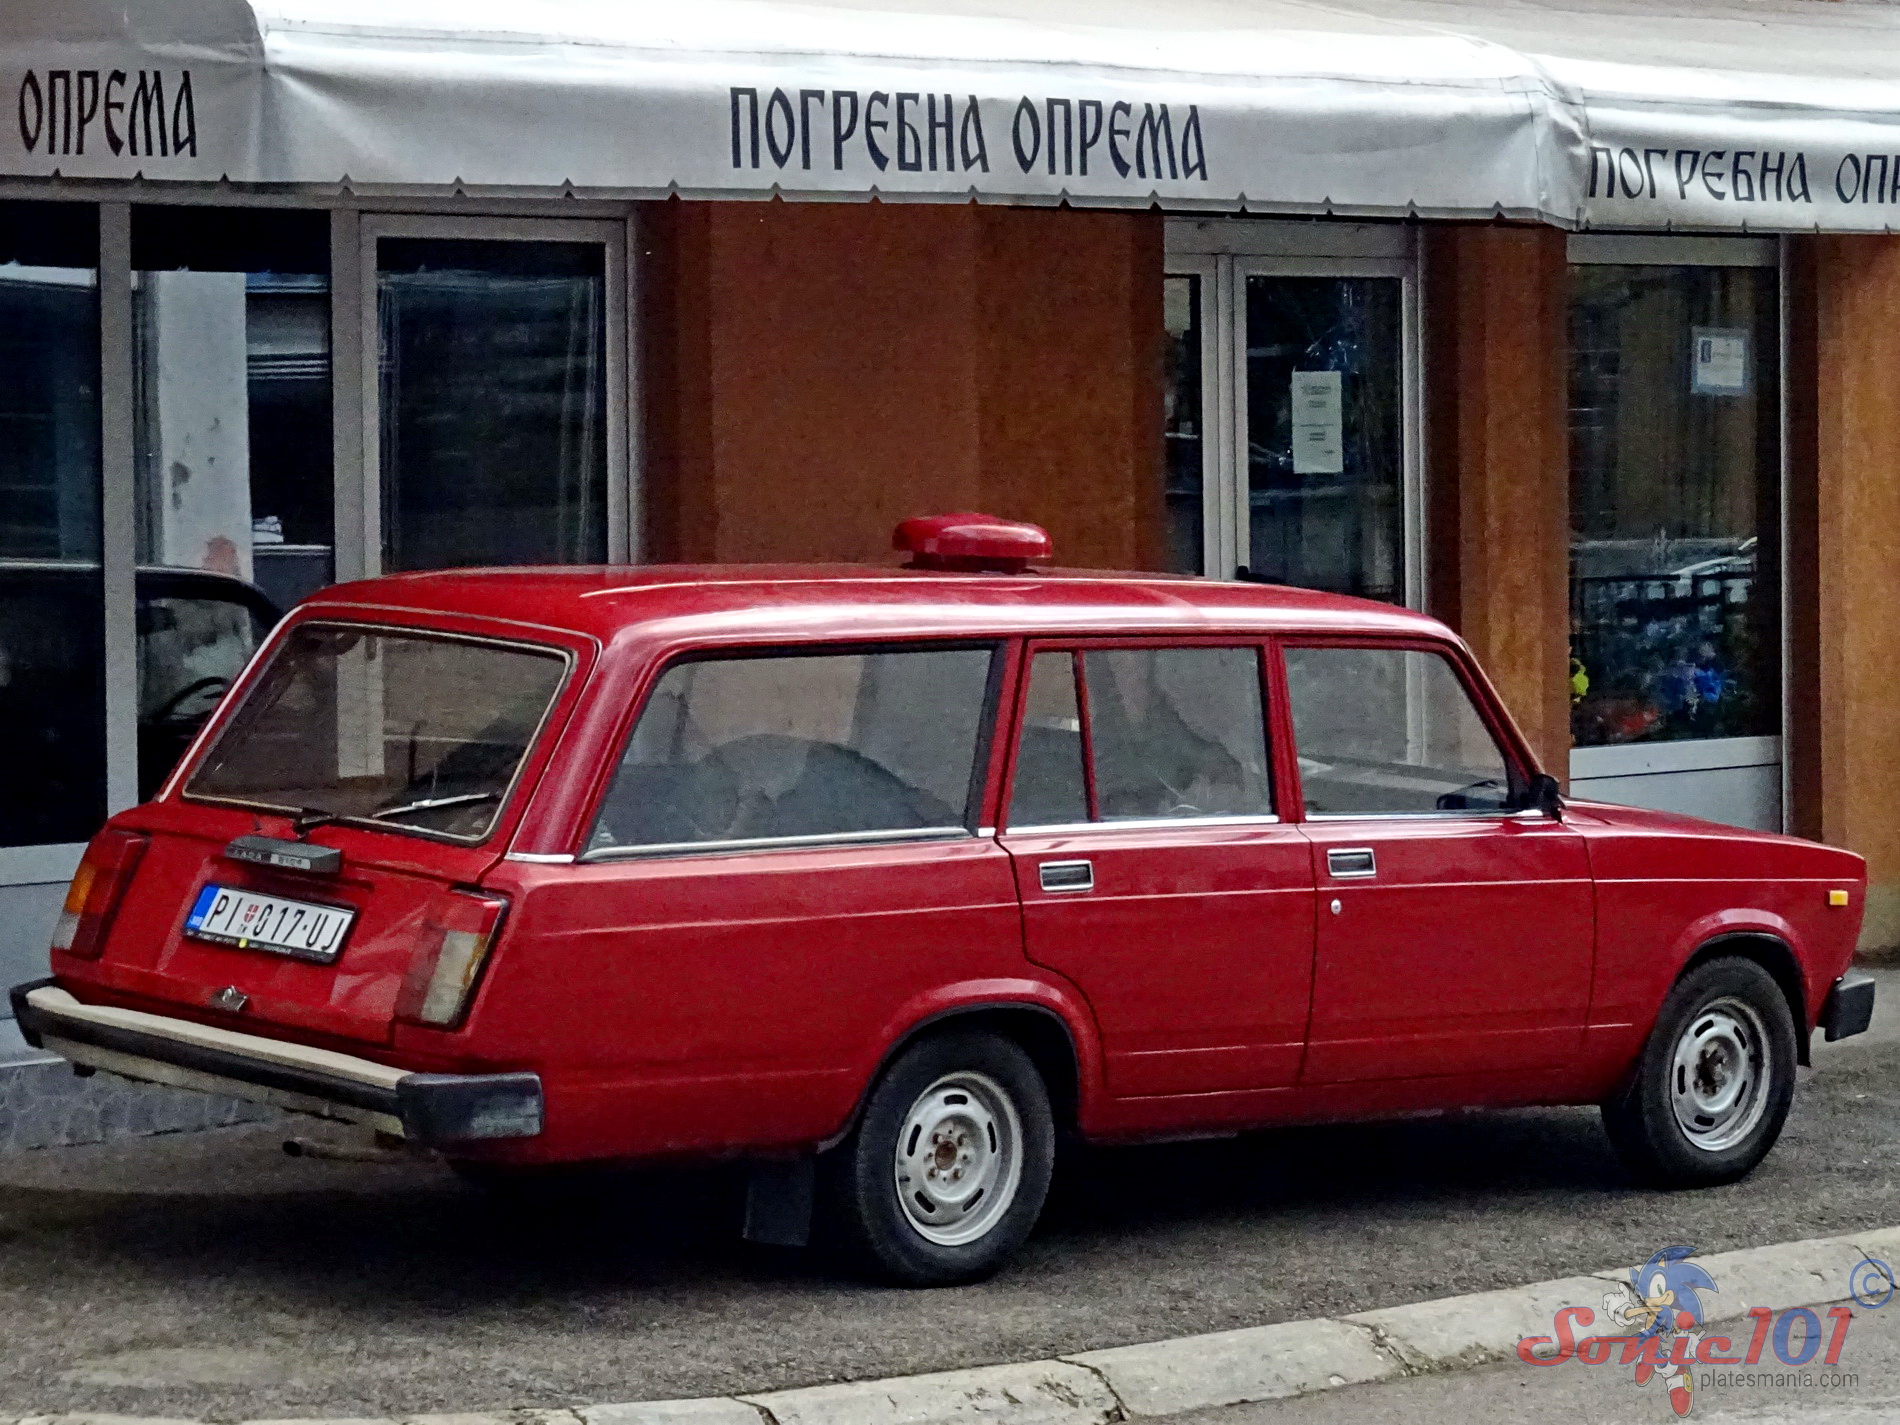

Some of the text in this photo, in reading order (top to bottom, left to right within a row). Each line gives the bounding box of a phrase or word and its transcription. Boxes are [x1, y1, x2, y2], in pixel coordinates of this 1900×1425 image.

[18, 69, 197, 158] ОПРЕМА
[730, 87, 1209, 181] ПОГРЕБНА ОПРЕМА
[1588, 146, 1813, 204] ПОГРЕБНА
[206, 894, 243, 932] PI
